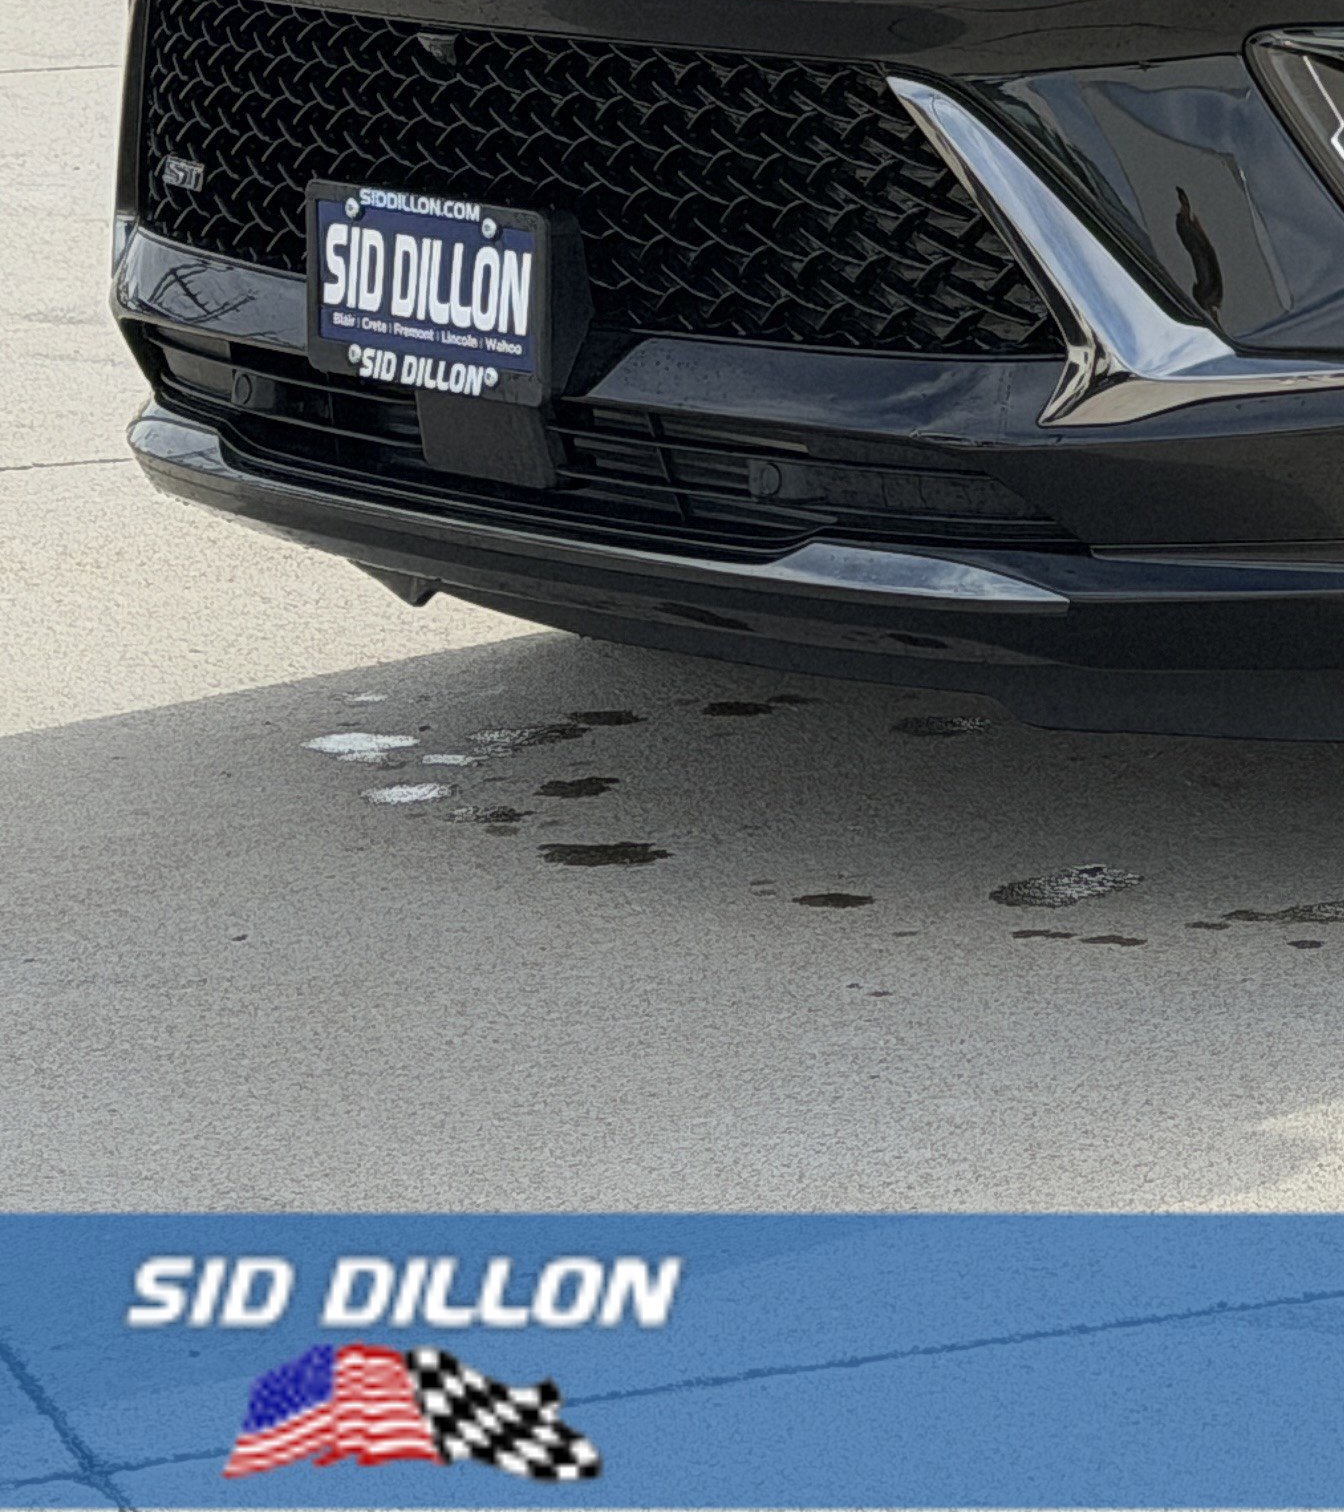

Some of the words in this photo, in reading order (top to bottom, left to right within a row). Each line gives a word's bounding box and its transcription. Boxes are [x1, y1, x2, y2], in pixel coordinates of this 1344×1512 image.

[359, 187, 480, 222] SIDDILLON.COM
[323, 223, 384, 313] SID
[391, 233, 532, 336] DILLON
[333, 312, 356, 329] Blair
[362, 317, 387, 334] Crete
[394, 322, 434, 342] Fremont
[441, 330, 479, 349] Lincoln
[485, 337, 522, 356] Wahoo
[359, 347, 397, 382] SID
[401, 358, 484, 397] DILLON
